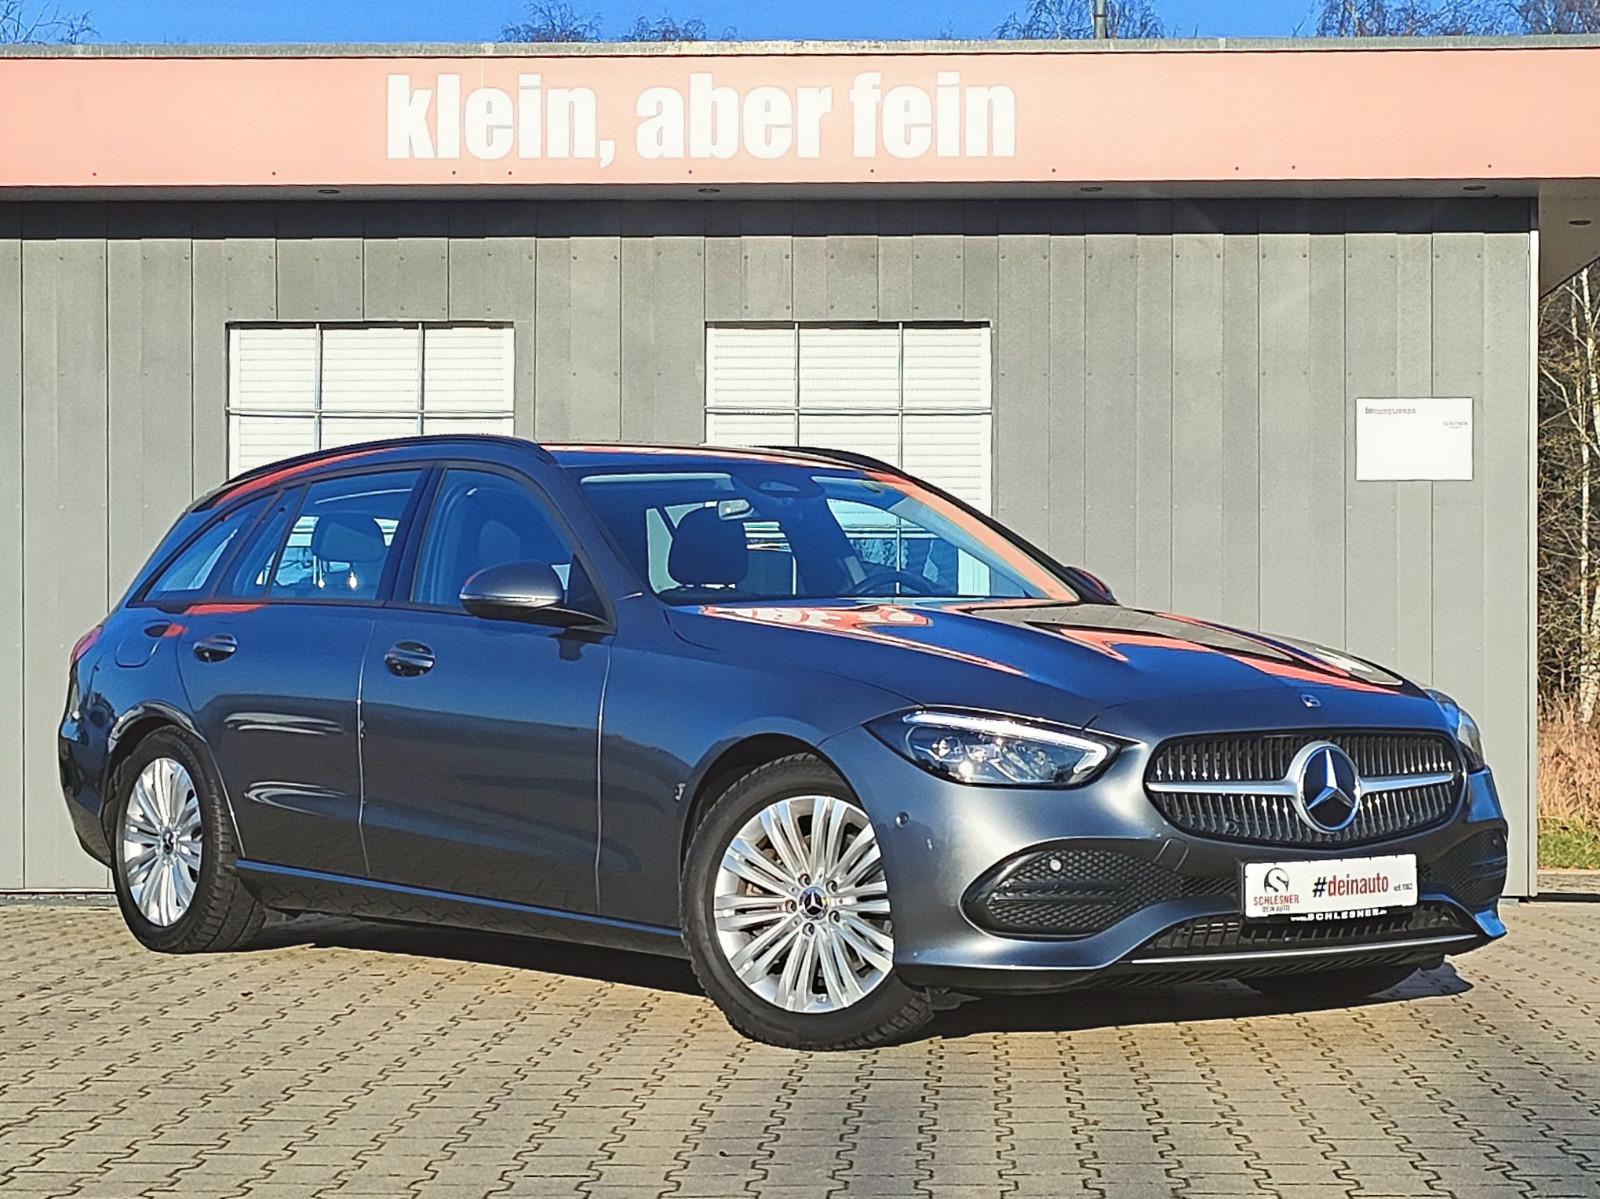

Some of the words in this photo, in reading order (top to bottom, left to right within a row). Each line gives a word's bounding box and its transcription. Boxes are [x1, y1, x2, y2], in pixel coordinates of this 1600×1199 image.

[386, 73, 615, 168] klein,
[635, 72, 833, 159] aber
[849, 71, 1017, 159] fein
[1312, 872, 1389, 898] #deinauto
[1253, 894, 1300, 906] SCHLESNER
